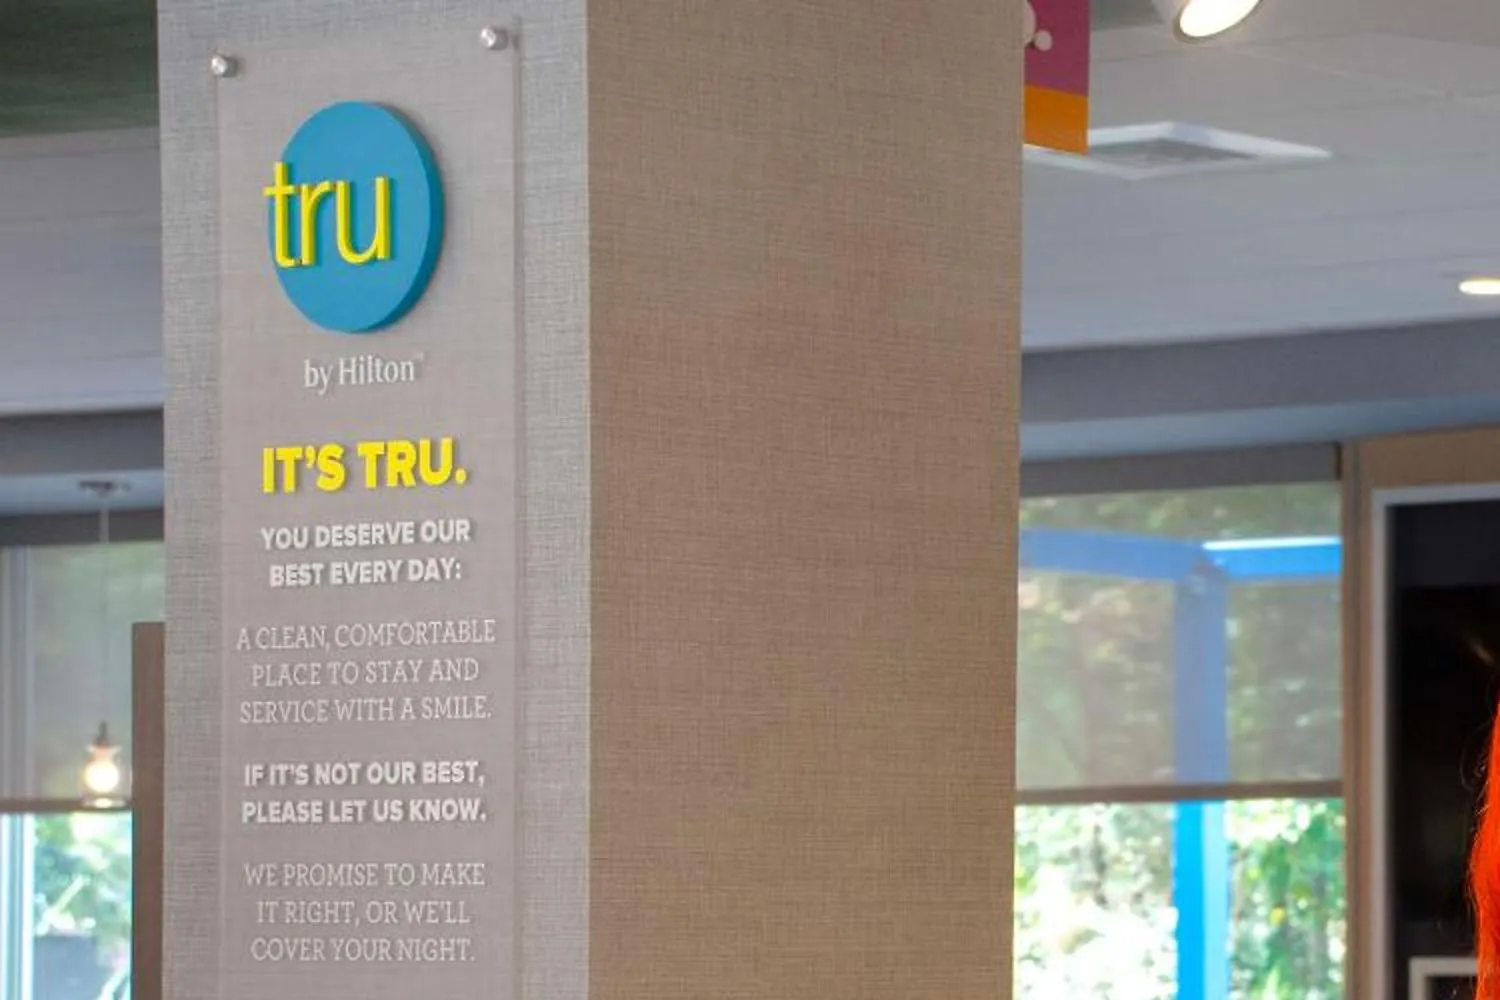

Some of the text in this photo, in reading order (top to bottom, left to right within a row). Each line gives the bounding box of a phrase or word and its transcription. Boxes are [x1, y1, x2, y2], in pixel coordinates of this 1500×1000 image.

[263, 161, 391, 268] tru
[304, 358, 334, 395] by
[262, 437, 467, 494] IT'S TRU.
[261, 519, 471, 550] YOU DESERVE OUR
[269, 557, 462, 587] BEST EVERY DAY:
[236, 619, 496, 651] A CLEAN, COMFORTABLE
[251, 658, 479, 688] PLACE TO STAY AND
[240, 695, 492, 724] SERVICE WITH A SMILE.
[244, 760, 485, 788] IF IT'S NOT OUR BEST,
[242, 798, 487, 823] PLEASE LET US KNOW.
[244, 862, 486, 887] WE PROMISE TO MAKE
[256, 900, 471, 928] IT RIGHT, OR WE'LL
[251, 938, 476, 961] COVER YOUR NIGHT.
